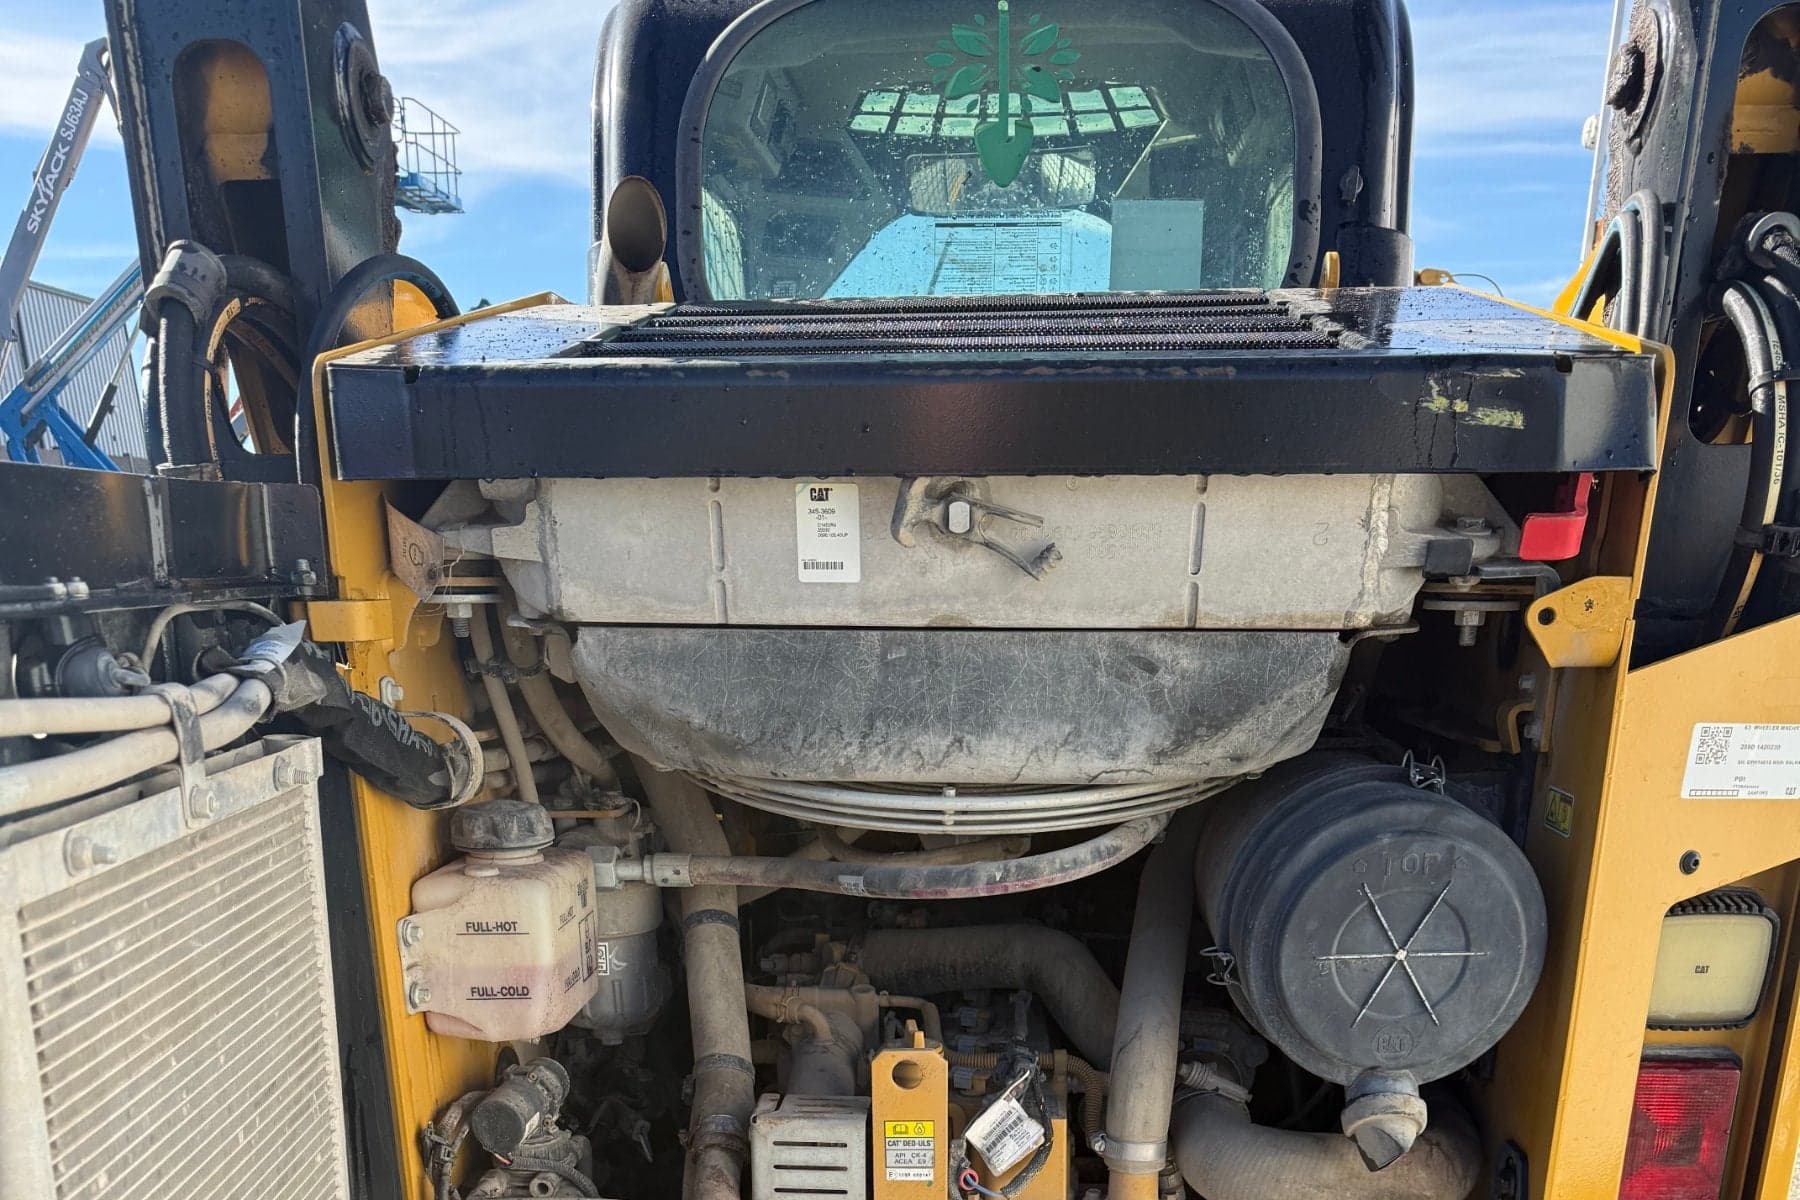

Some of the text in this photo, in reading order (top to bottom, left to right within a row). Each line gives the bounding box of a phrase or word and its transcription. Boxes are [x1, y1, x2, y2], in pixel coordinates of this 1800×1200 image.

[27, 88, 88, 234] SKYJACK SJ63AJ
[1778, 394, 1787, 429] MSHA
[810, 488, 829, 501] CAT
[465, 921, 518, 932] FULL-HOT
[1695, 965, 1710, 973] CAT
[471, 986, 530, 997] FULL-COLD
